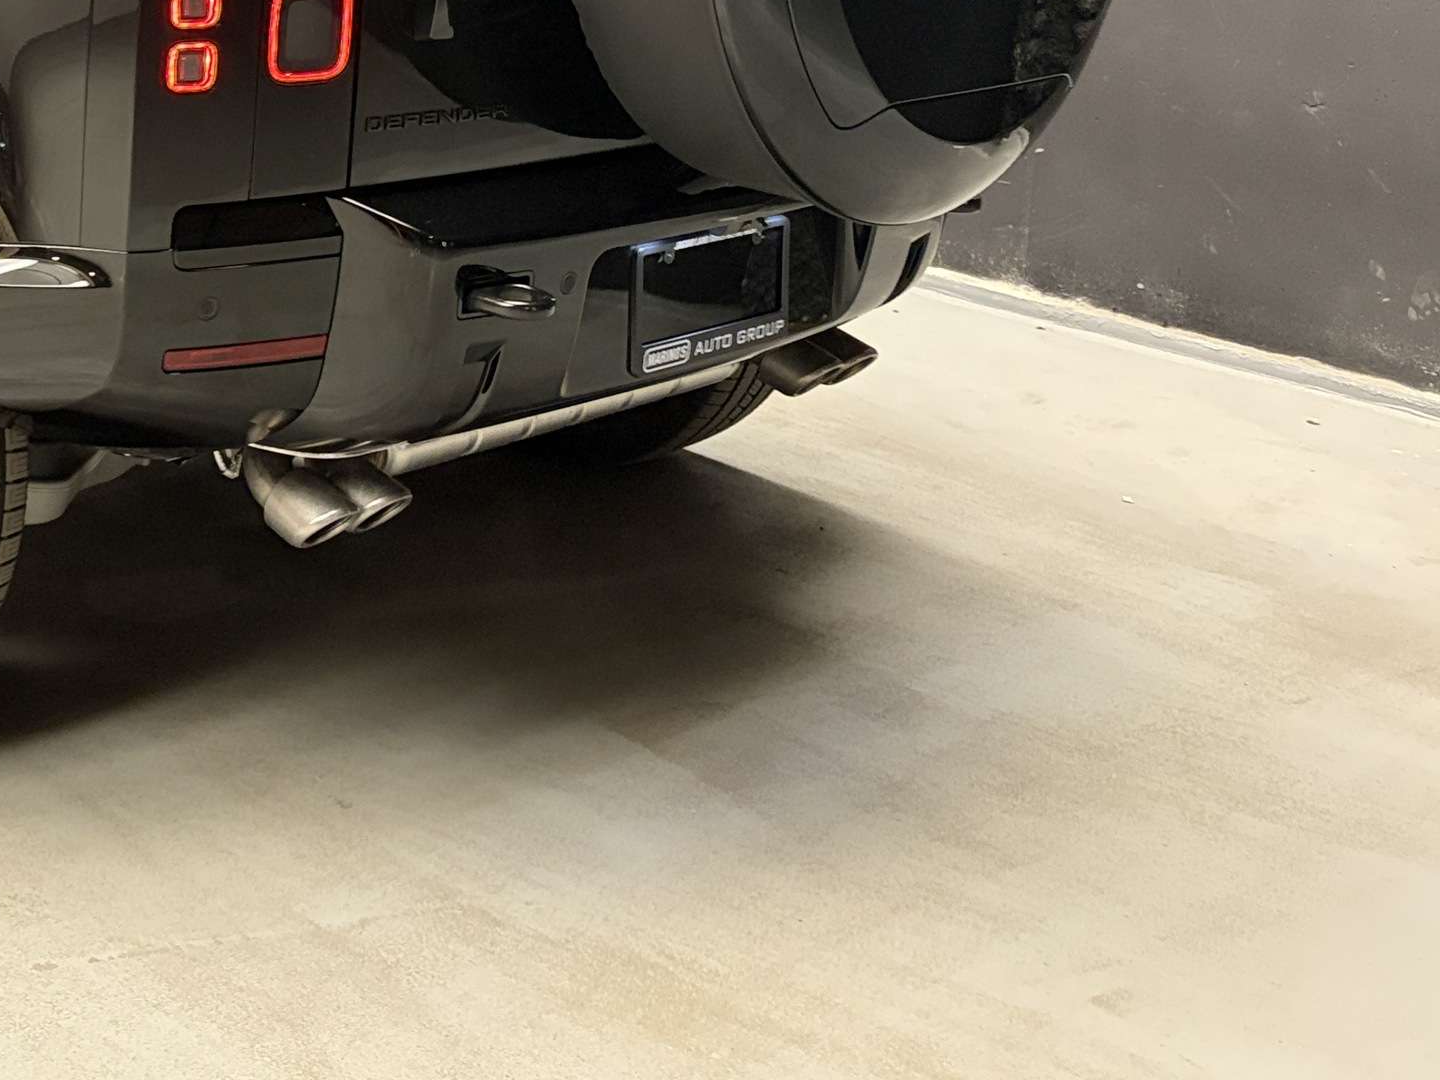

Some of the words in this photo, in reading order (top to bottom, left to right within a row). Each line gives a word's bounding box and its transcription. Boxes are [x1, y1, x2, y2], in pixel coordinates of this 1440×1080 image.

[364, 103, 509, 132] DEFENDER
[693, 333, 733, 356] AUTO
[736, 319, 785, 345] GROUP
